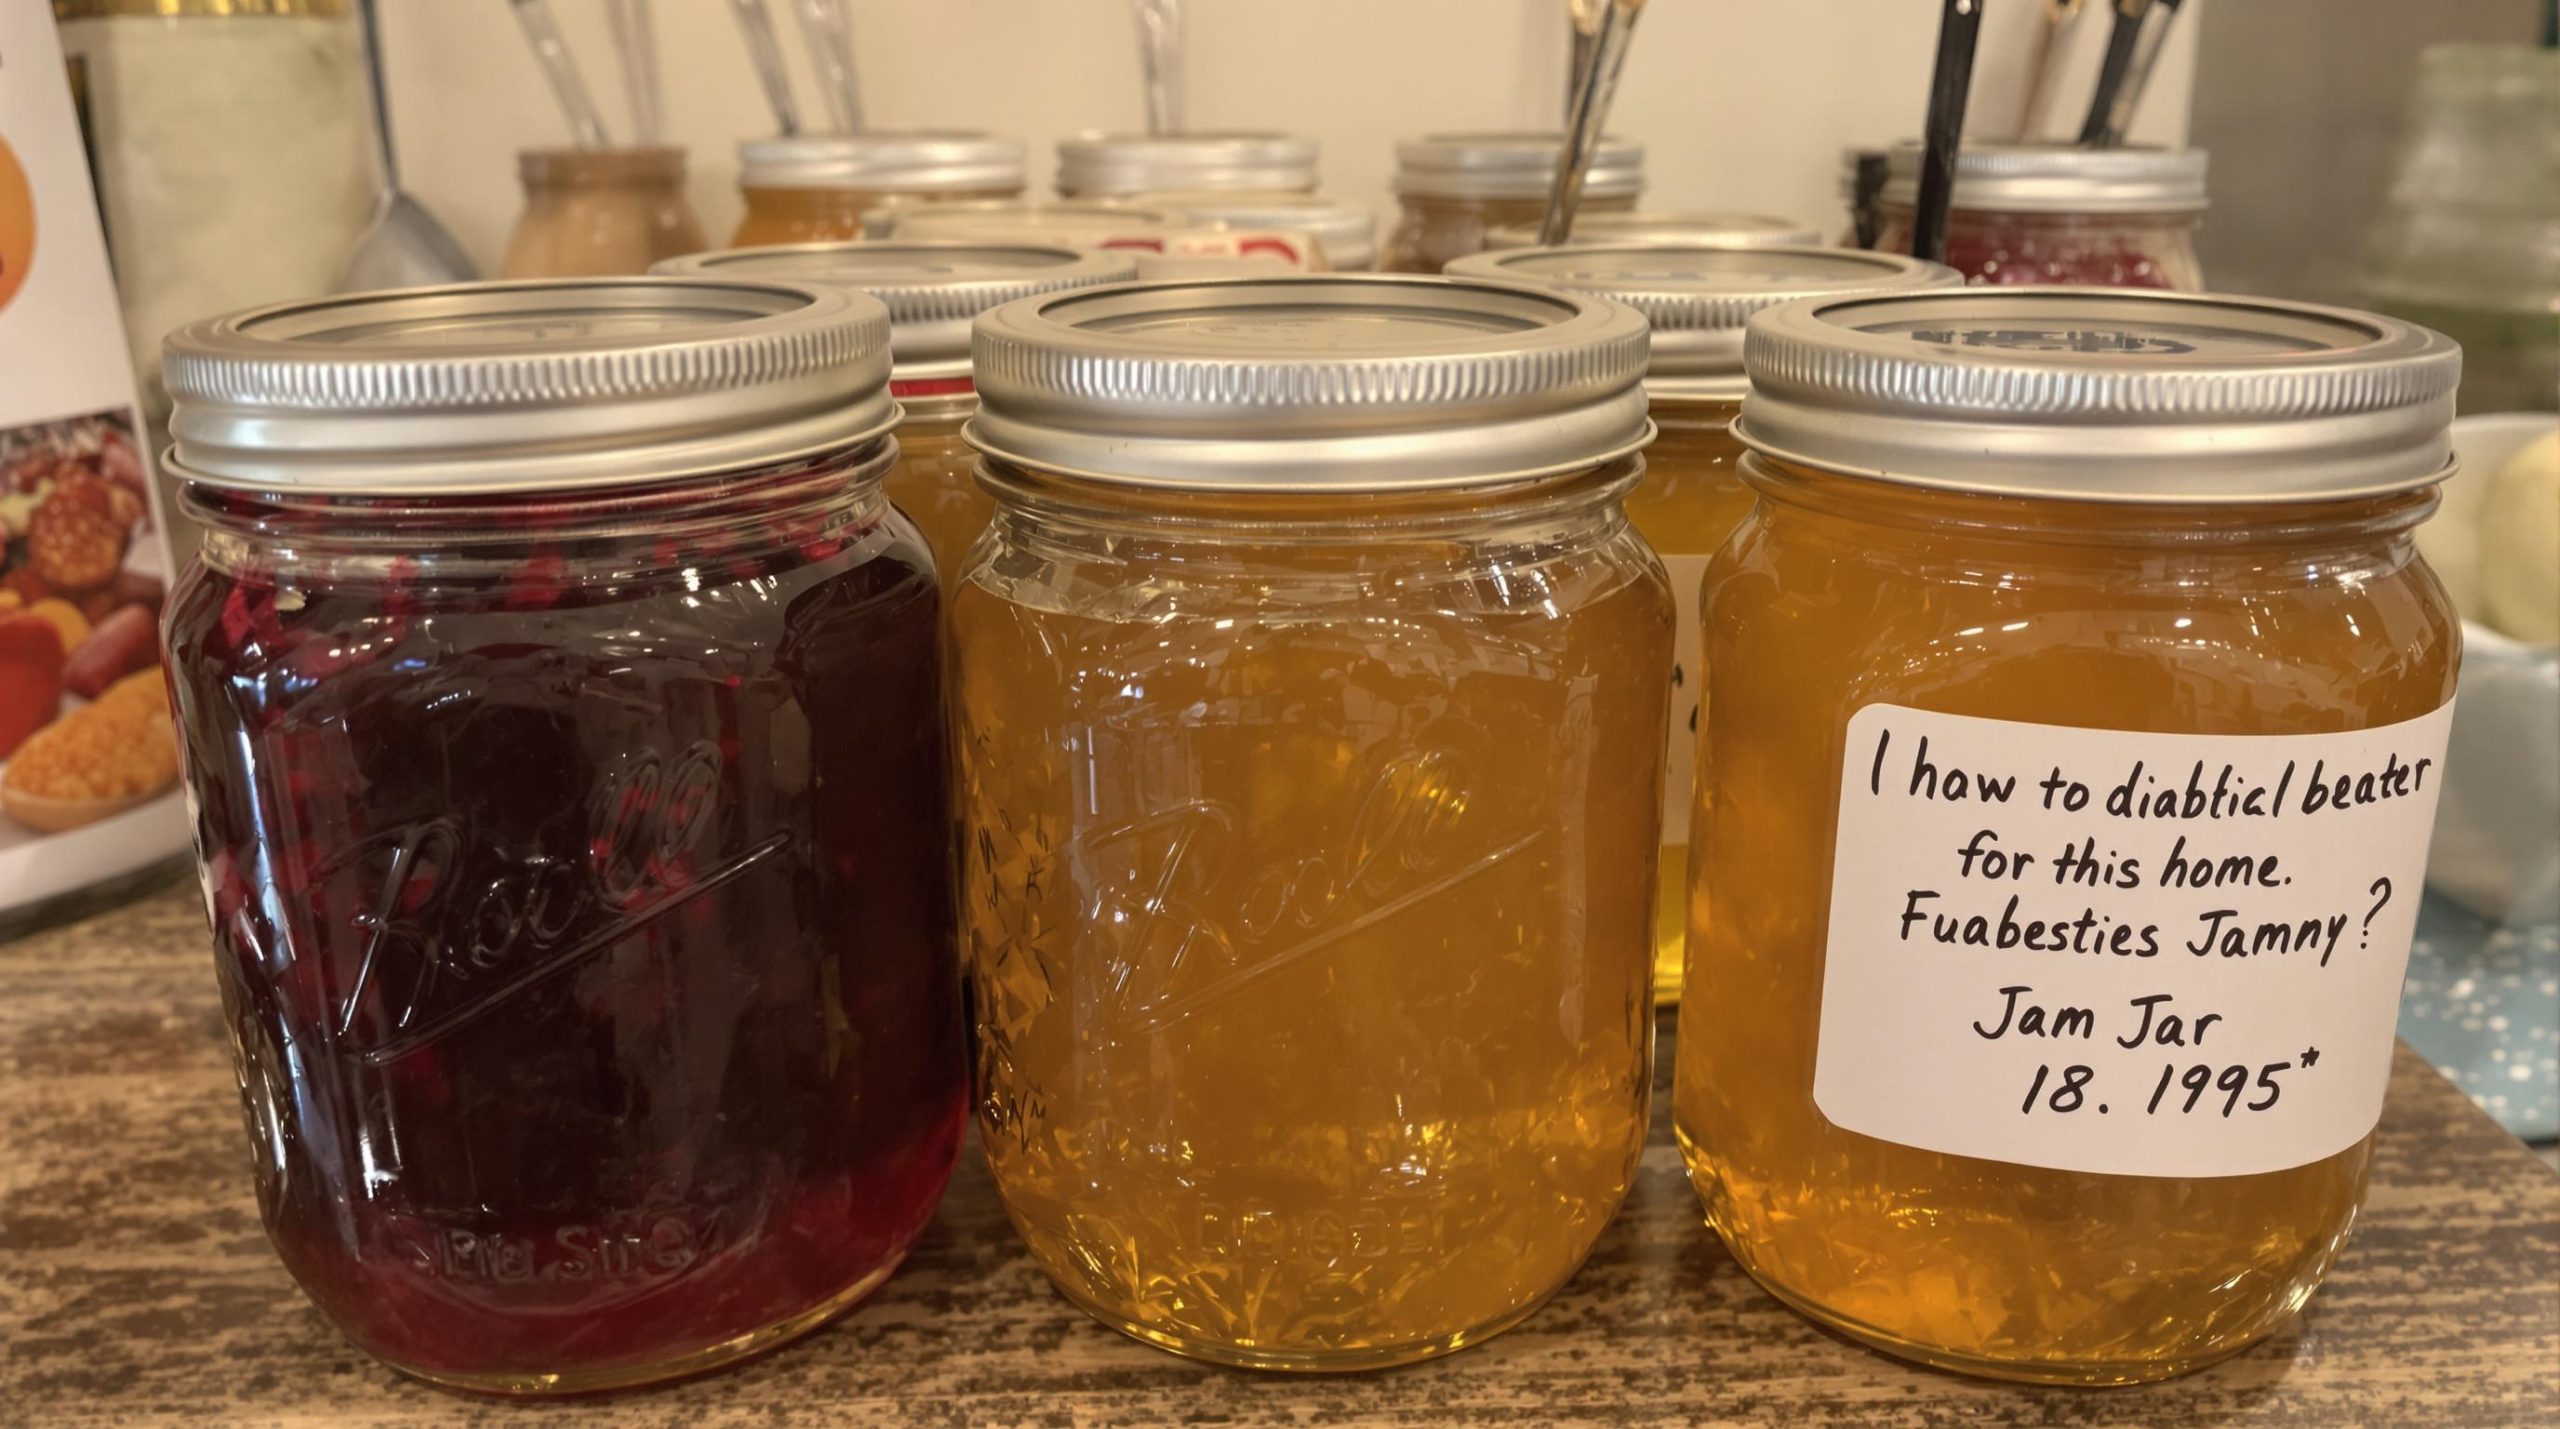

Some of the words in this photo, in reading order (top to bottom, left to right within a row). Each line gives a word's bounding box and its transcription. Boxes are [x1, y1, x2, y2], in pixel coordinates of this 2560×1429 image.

[2039, 766, 2090, 812] to
[2301, 752, 2432, 815] beater
[1957, 829, 2036, 881] for
[2052, 836, 2140, 889] this
[2159, 835, 2292, 888] home.
[1900, 889, 2159, 958] Fuabesties
[1972, 985, 2095, 1040] Jam
[2116, 994, 2223, 1050] Jar
[2021, 1064, 2109, 1115] 18.
